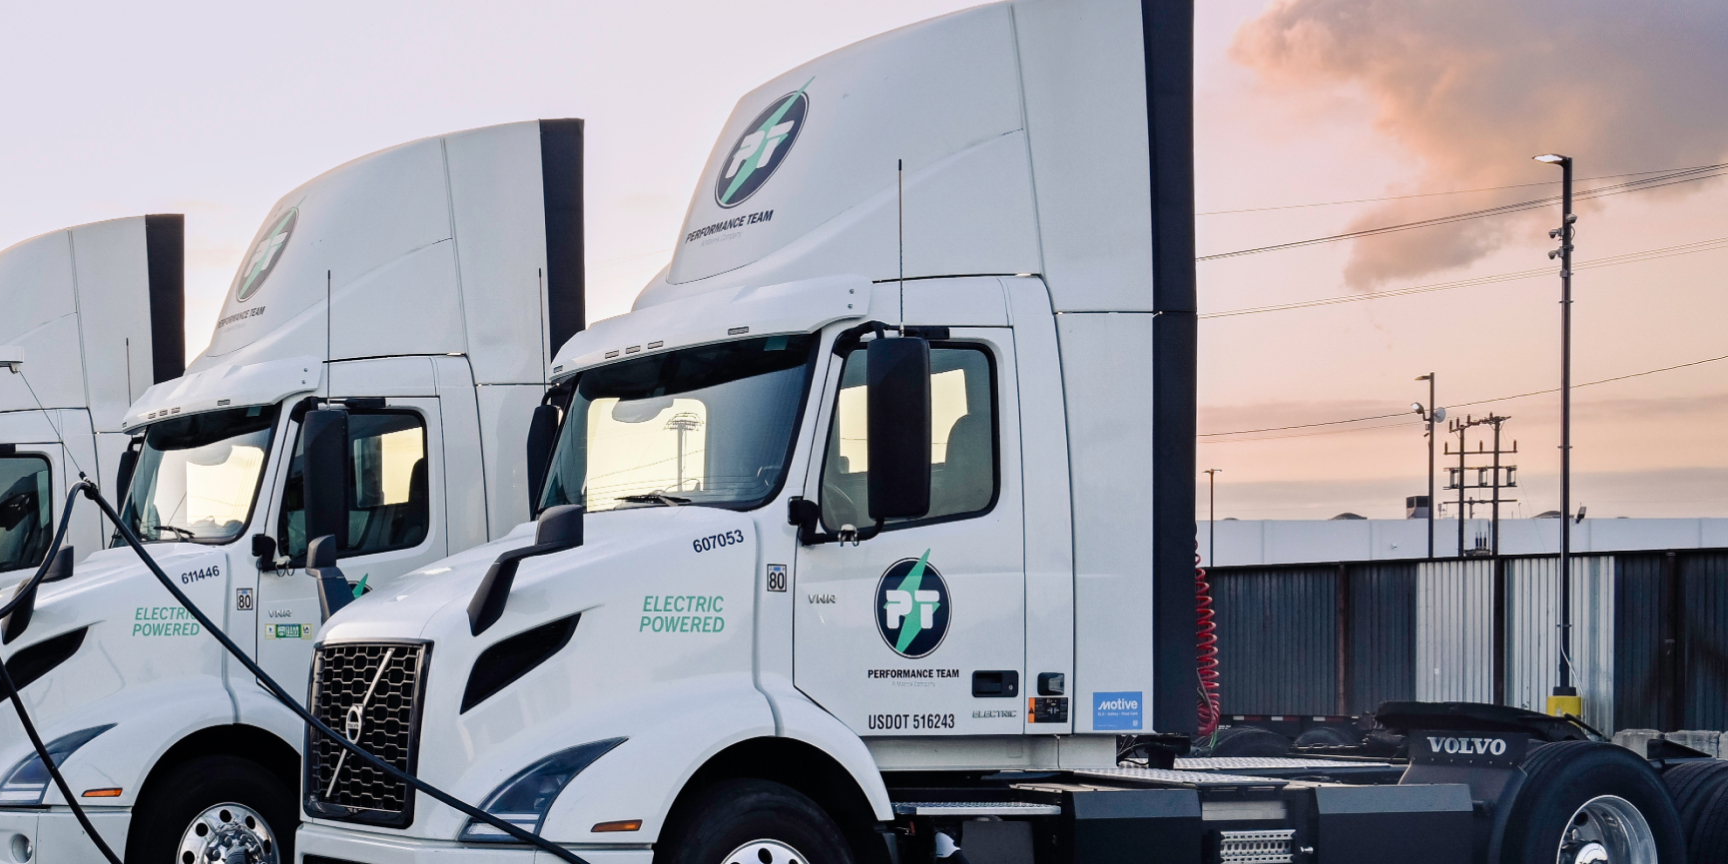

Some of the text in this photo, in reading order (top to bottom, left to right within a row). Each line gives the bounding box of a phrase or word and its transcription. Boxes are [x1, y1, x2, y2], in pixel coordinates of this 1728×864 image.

[725, 120, 795, 179] PT
[685, 209, 774, 244] PERFORMANCE TEAM
[249, 305, 266, 318] TEAM
[693, 529, 744, 553] 607053
[181, 565, 220, 585] 611446
[769, 571, 785, 589] 80
[238, 594, 251, 609] 80
[642, 596, 724, 613] ELECTRIC
[886, 590, 940, 629] PT
[132, 623, 200, 637] POWERED
[639, 616, 725, 633] POWERED
[868, 669, 960, 679] PERFORMANCE TEAM
[868, 713, 955, 730] USDOT 516243
[972, 710, 1017, 719] ELECTRIC
[1426, 736, 1507, 756] VOLVO
